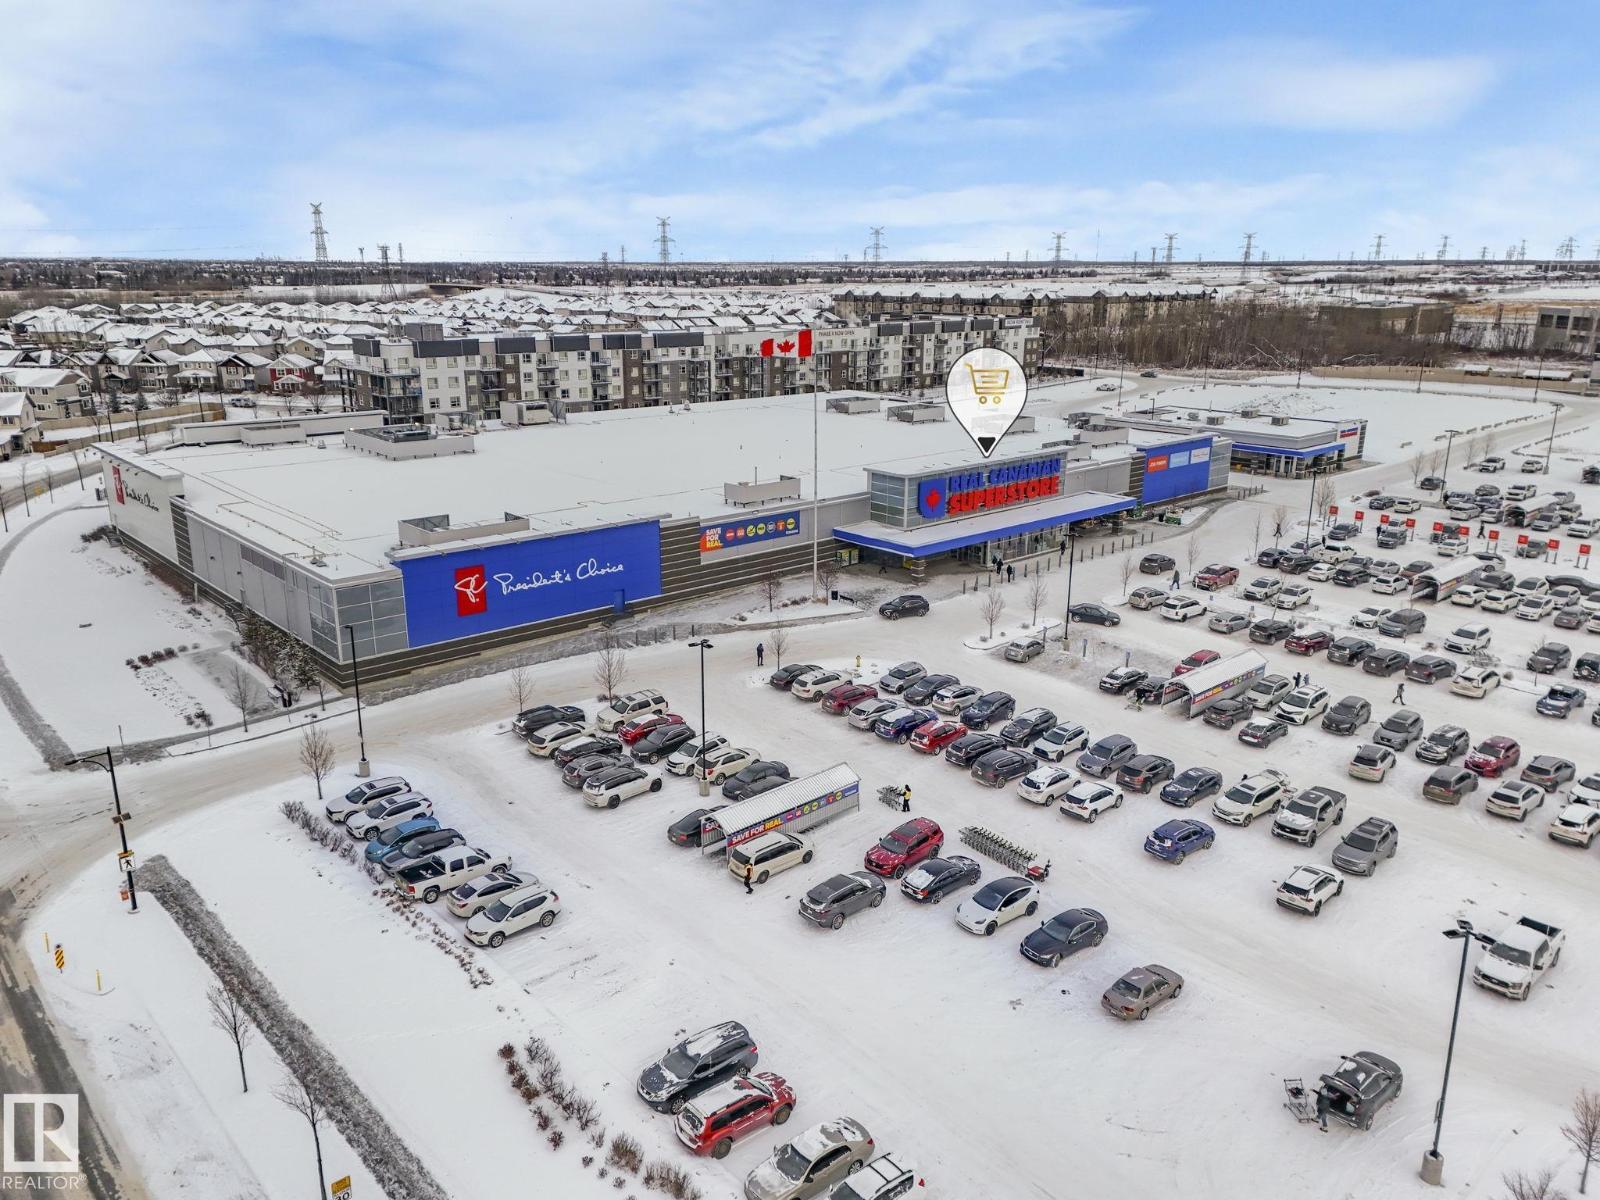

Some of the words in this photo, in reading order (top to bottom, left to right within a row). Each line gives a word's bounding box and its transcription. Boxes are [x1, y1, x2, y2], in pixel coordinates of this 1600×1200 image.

[948, 471, 985, 493] REAL
[987, 458, 1061, 485] CANADIAN
[947, 475, 1060, 518] SUPERSTORE
[493, 569, 572, 595] President's
[576, 558, 624, 580] Choice
[732, 830, 750, 844] SAVE
[750, 824, 765, 837] FOR
[765, 817, 784, 831] REAL
